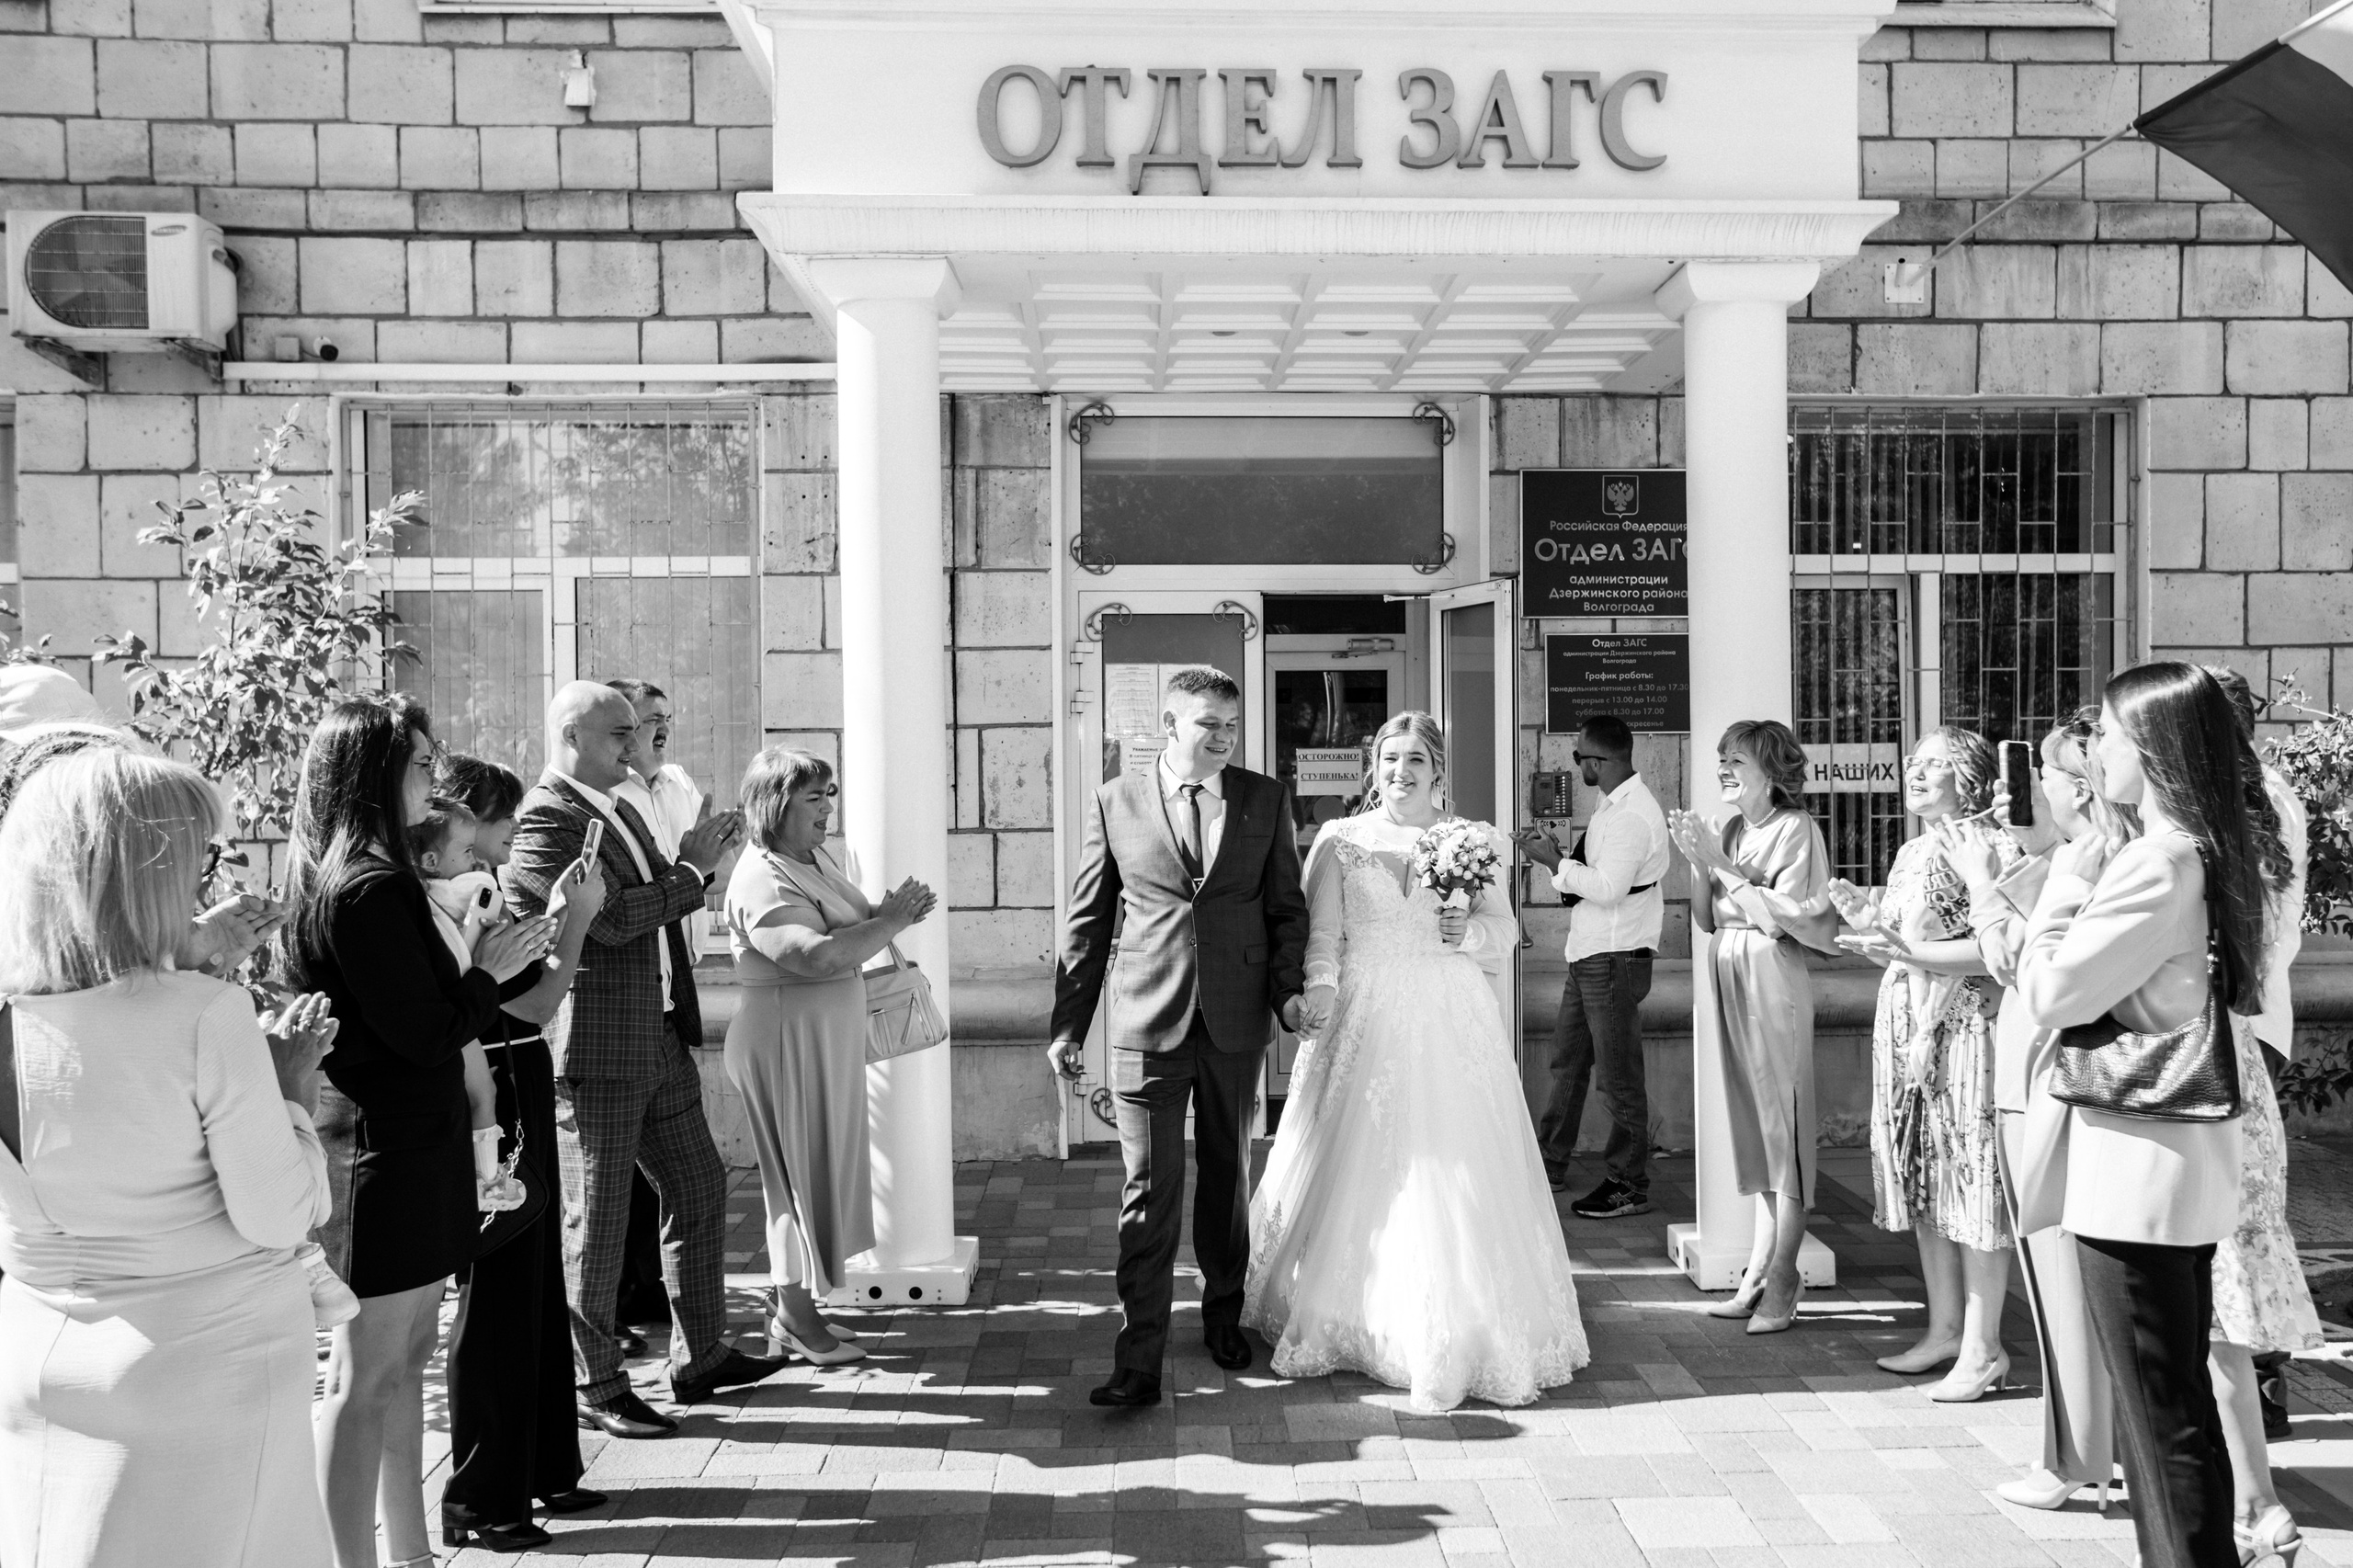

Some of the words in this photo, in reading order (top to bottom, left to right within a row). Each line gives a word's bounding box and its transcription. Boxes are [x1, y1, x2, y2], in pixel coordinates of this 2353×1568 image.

[976, 64, 1363, 197] ОТДЕЛ
[1397, 68, 1669, 171] ЗАГС
[1550, 520, 1620, 531] Российская
[1621, 521, 1688, 533] Федерация
[1534, 538, 1625, 565] Отдел
[1569, 574, 1668, 585] администрации
[1549, 588, 1640, 599] Дзержинского
[1643, 588, 1688, 599] района
[1584, 602, 1654, 613] Волгограда
[1592, 639, 1621, 648] Отдел
[1623, 638, 1647, 647] ЗАГС
[1609, 649, 1653, 657] Дзержинского
[1586, 672, 1618, 681] График
[1619, 671, 1654, 681] работы:
[1298, 753, 1359, 761] ОСТОРОЖНО!
[1814, 763, 1895, 781] НАШИХ
